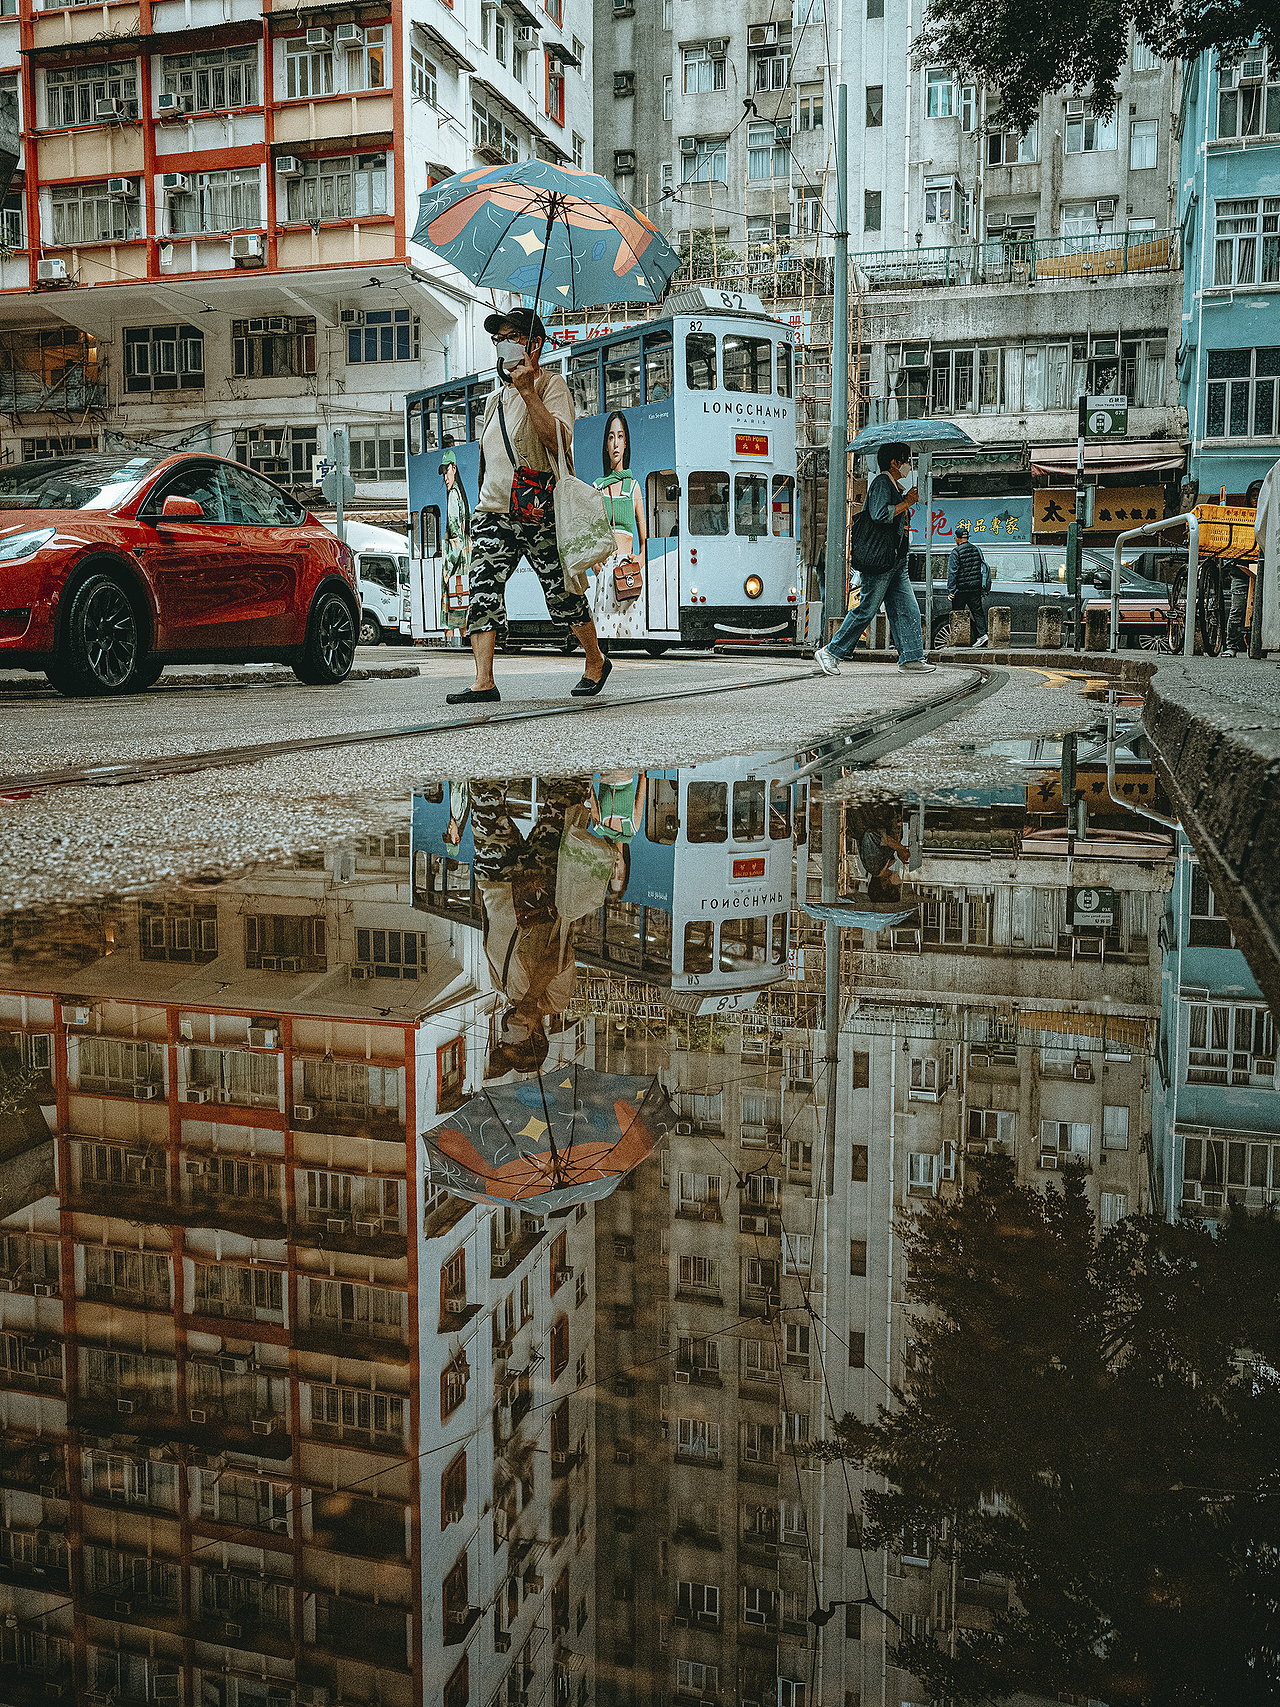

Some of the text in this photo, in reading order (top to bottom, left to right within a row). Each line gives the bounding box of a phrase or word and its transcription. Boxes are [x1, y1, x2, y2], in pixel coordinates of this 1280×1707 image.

[720, 292, 747, 310] 82
[690, 320, 703, 332] 82
[785, 331, 793, 342] 82
[703, 401, 788, 419] LONGCHAMP
[736, 434, 767, 443] North Point
[955, 515, 1020, 536] 甜品專家
